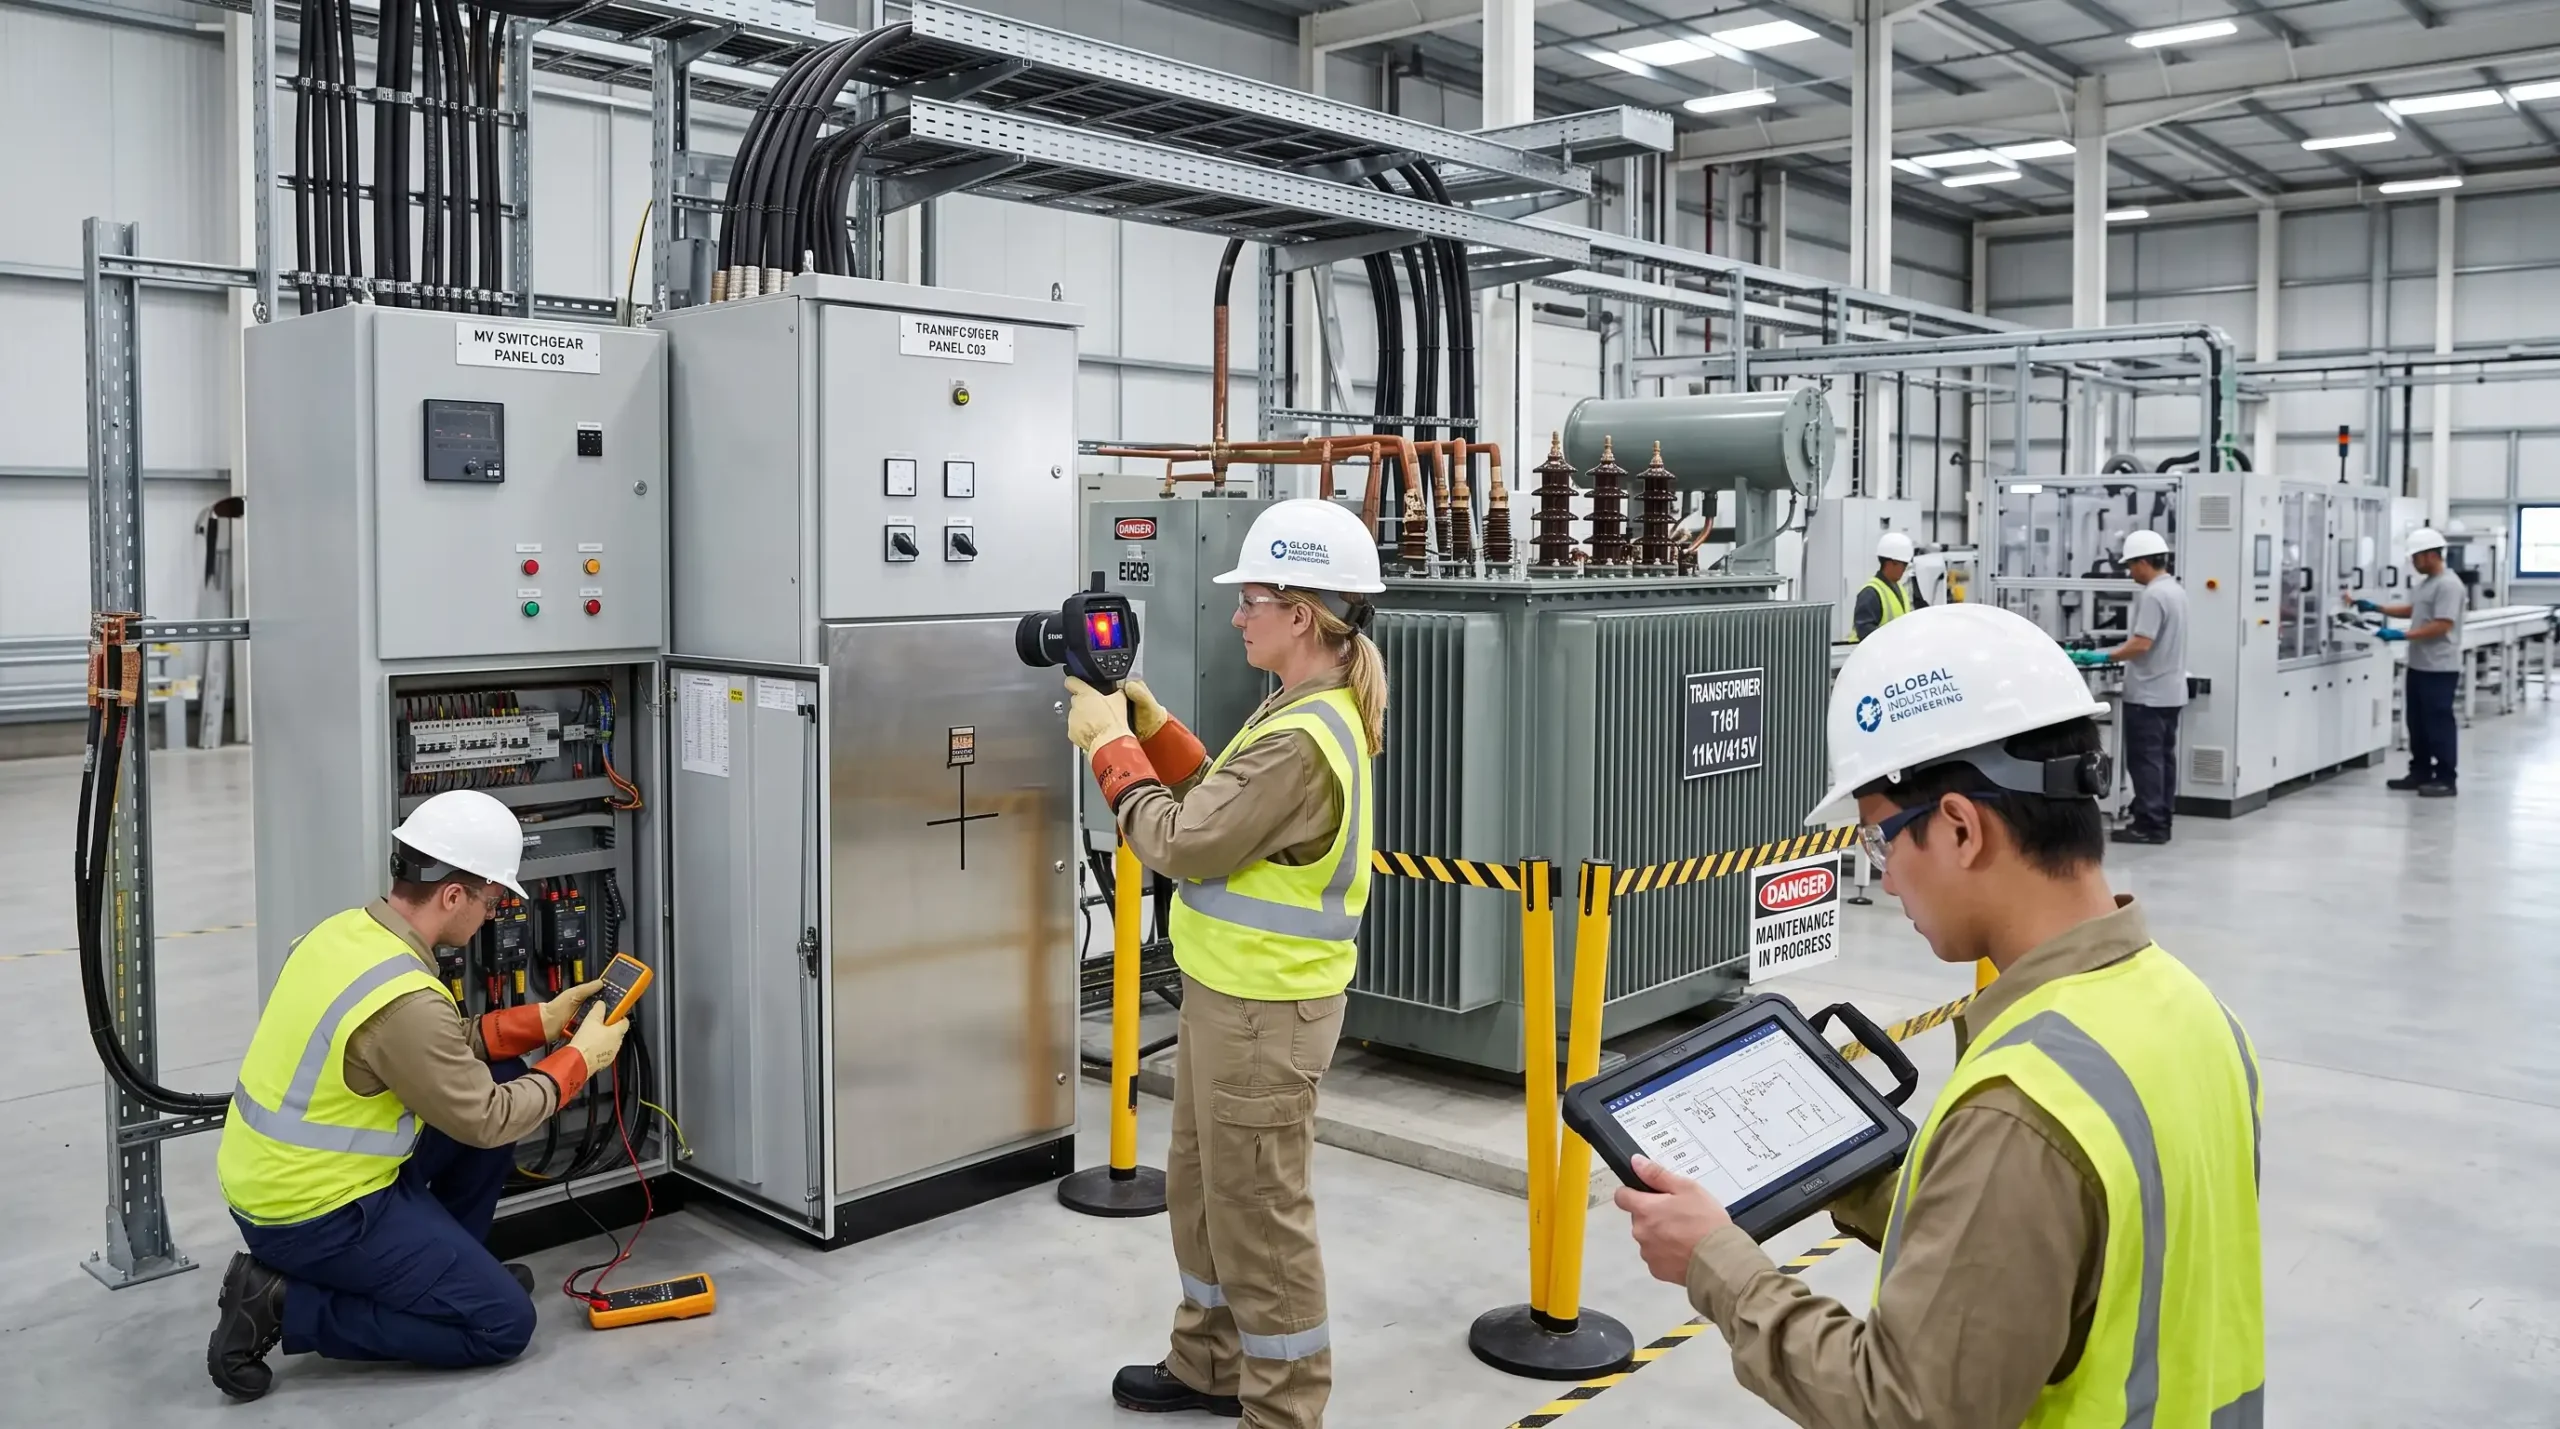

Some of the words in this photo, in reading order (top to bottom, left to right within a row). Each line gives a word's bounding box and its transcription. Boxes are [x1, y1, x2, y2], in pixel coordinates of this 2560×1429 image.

[474, 329, 494, 343] MV
[498, 332, 584, 350] SWITCHGEAR
[929, 340, 964, 354] PANEL
[967, 343, 986, 356] C03
[494, 349, 538, 364] PANEL
[541, 353, 565, 366] C03
[1119, 524, 1152, 534] DANGER
[1289, 541, 1328, 552] GLOBAL
[1689, 677, 1761, 704] TRANSFORMER
[1884, 668, 1954, 699] GLOBAL
[1887, 682, 1959, 712] INDUSTRIAL
[1890, 693, 1964, 723] ENGINEERING
[1692, 735, 1758, 768] 11kV/415V
[1767, 874, 1827, 905] DANGER
[1755, 909, 1835, 945] MAINTENANCE
[1758, 948, 1771, 968] IN
[1774, 932, 1832, 964] PROGRESS
